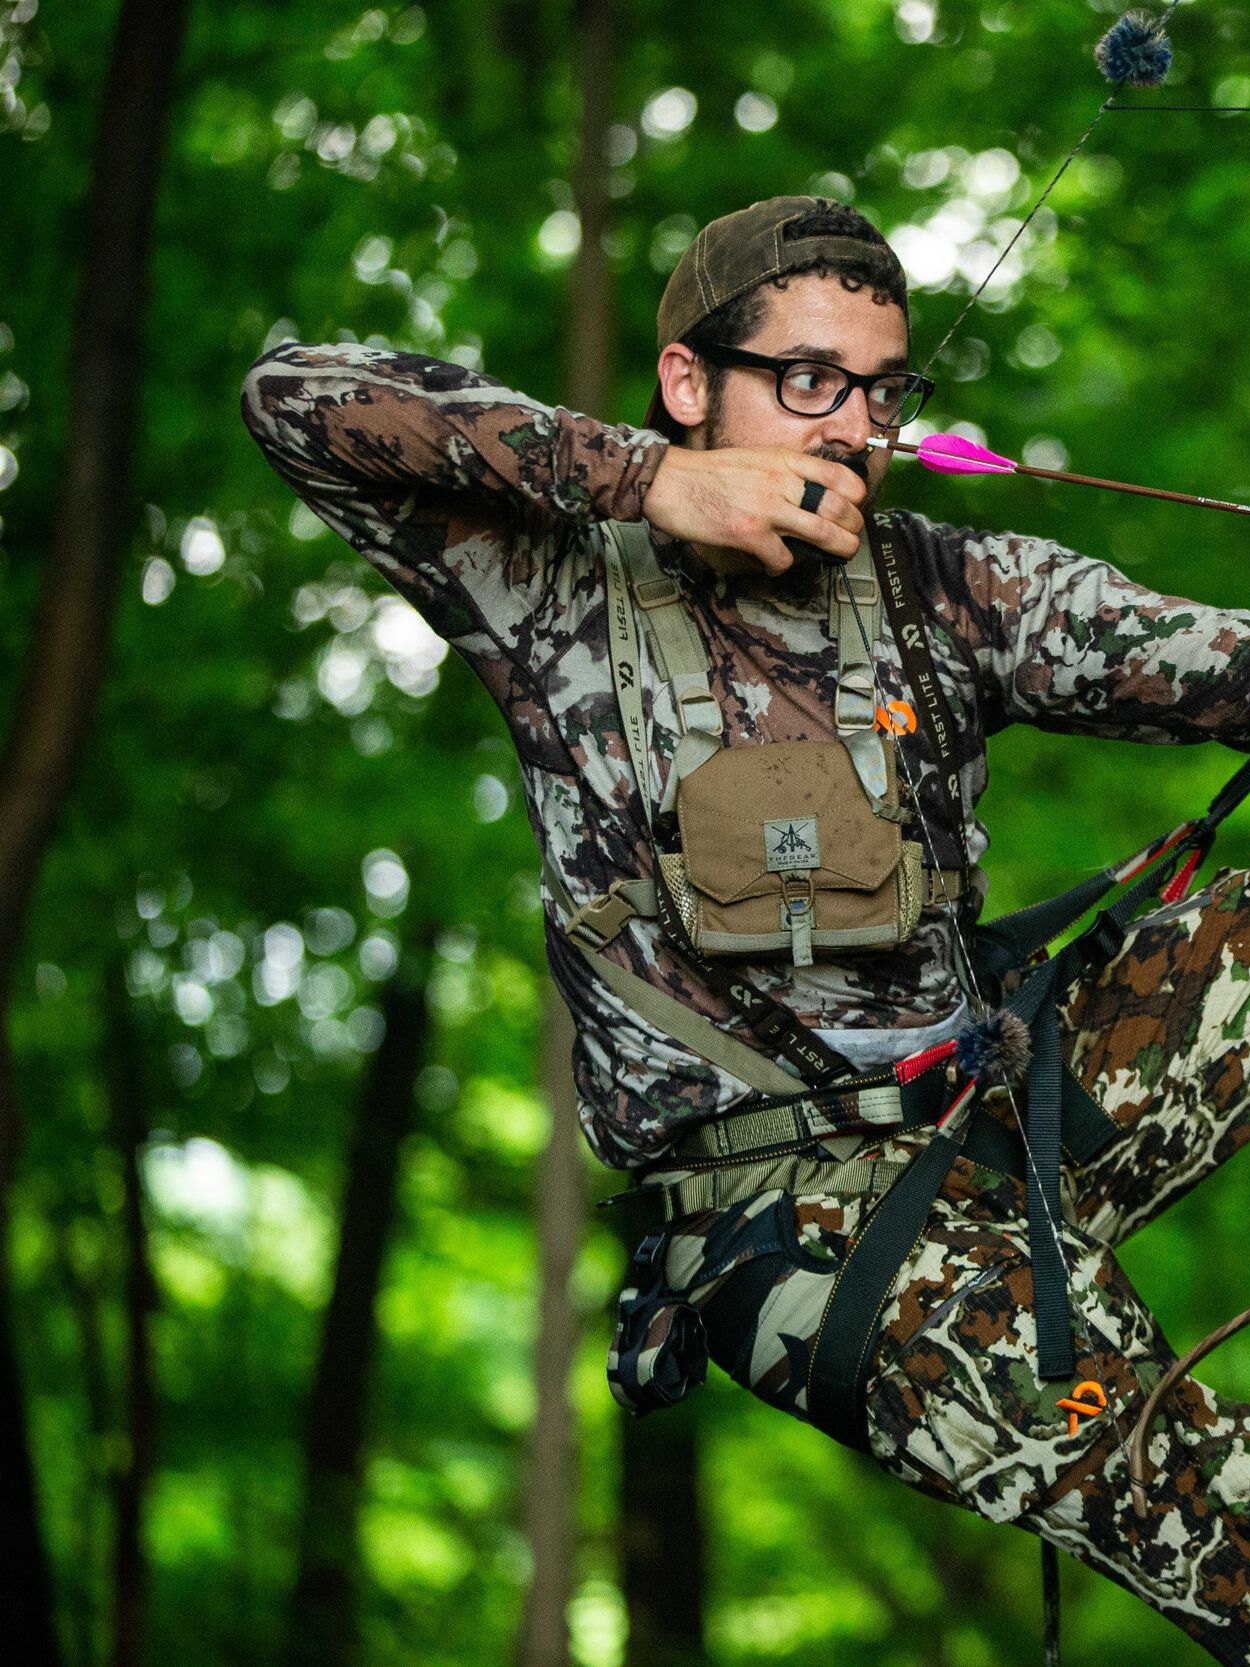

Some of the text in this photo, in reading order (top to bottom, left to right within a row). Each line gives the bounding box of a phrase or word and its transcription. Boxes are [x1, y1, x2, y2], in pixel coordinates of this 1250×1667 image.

[881, 542, 906, 609] FIRST LITE
[918, 672, 950, 758] FIRST LITE
[797, 1045, 830, 1074] IRST
